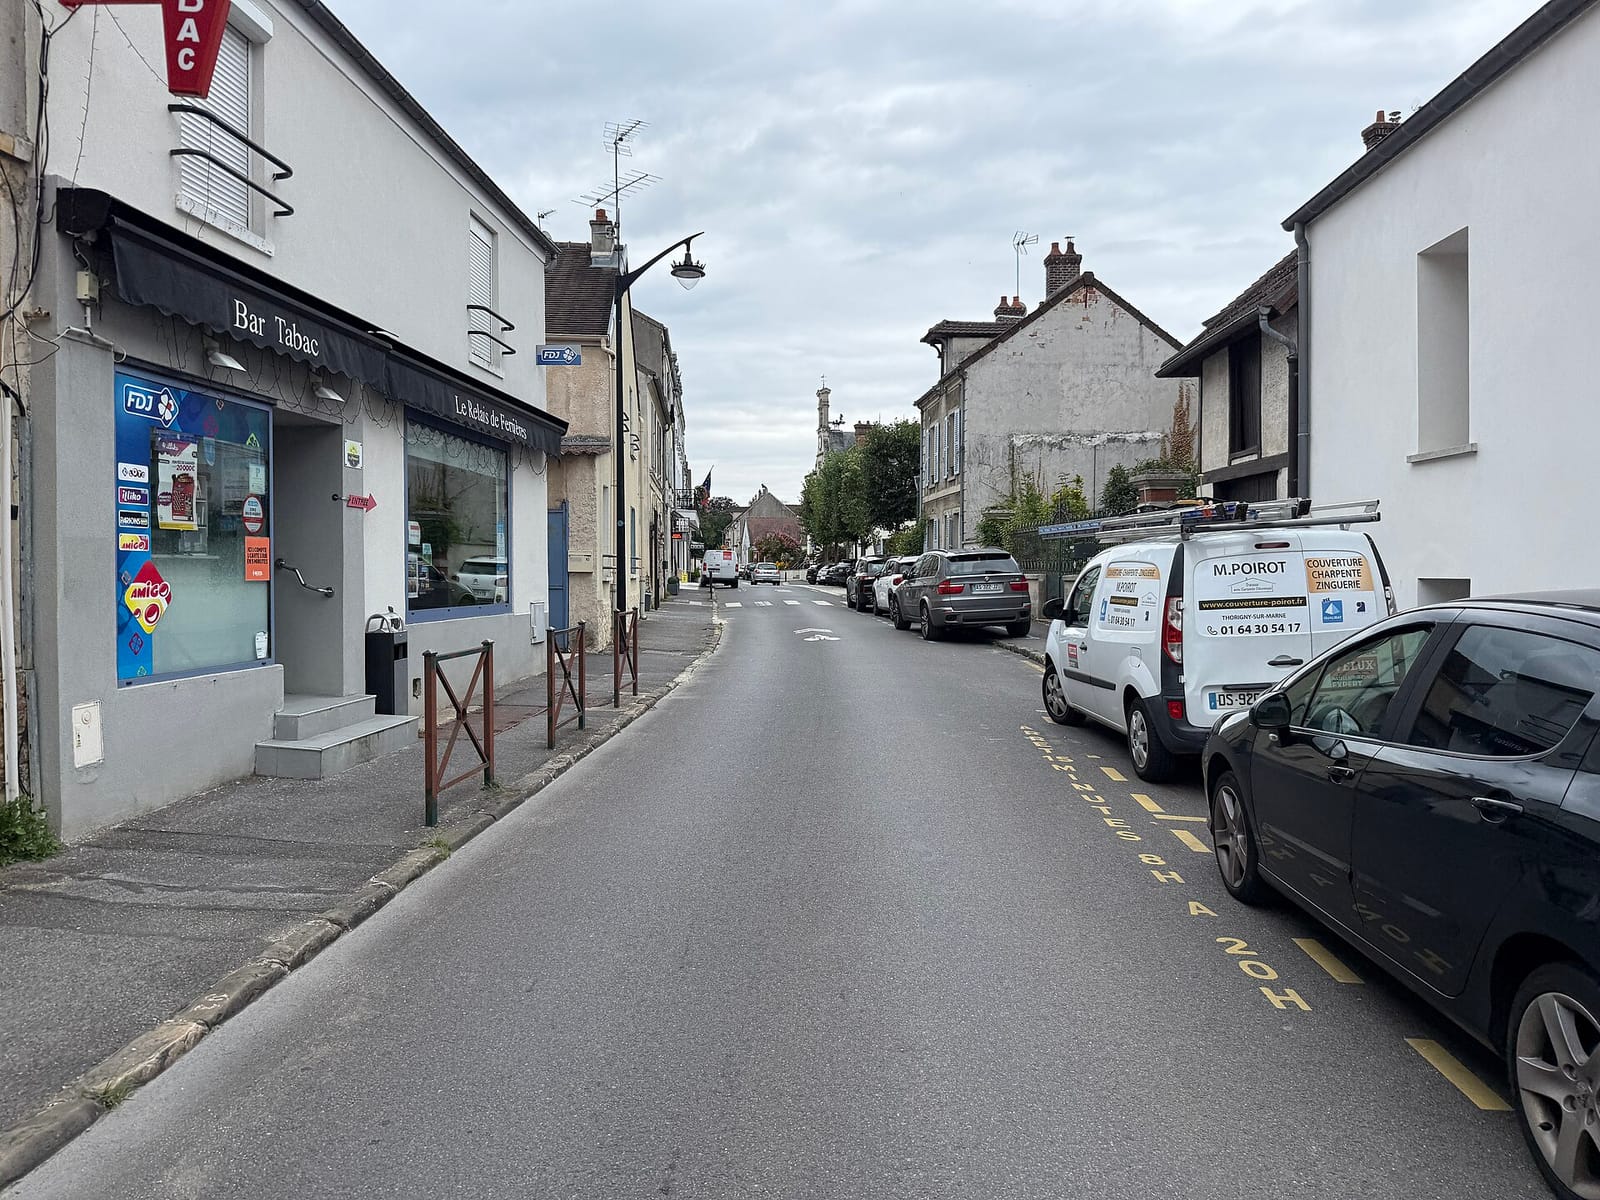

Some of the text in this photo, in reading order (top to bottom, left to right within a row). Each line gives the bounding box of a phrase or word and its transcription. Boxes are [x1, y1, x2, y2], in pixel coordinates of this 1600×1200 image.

[233, 298, 319, 357] Bar Tabac
[543, 351, 560, 359] FDJ
[127, 390, 154, 412] FDJ
[454, 394, 527, 440] Le Relais de Ferrières
[1213, 561, 1287, 576] M.POIROT
[1306, 557, 1364, 569] COUVERTURE
[1311, 568, 1362, 579] CHARPENTE
[1315, 579, 1361, 590] ZINGUERIE
[1202, 598, 1304, 608] www.couverture-poirot.fr
[1220, 623, 1301, 635] 01 64 30 54 17
[1337, 660, 1375, 672] ELUX
[1052, 764, 1142, 841] MINUTES
[1188, 900, 1219, 917] A
[1216, 937, 1312, 1011] 20H
